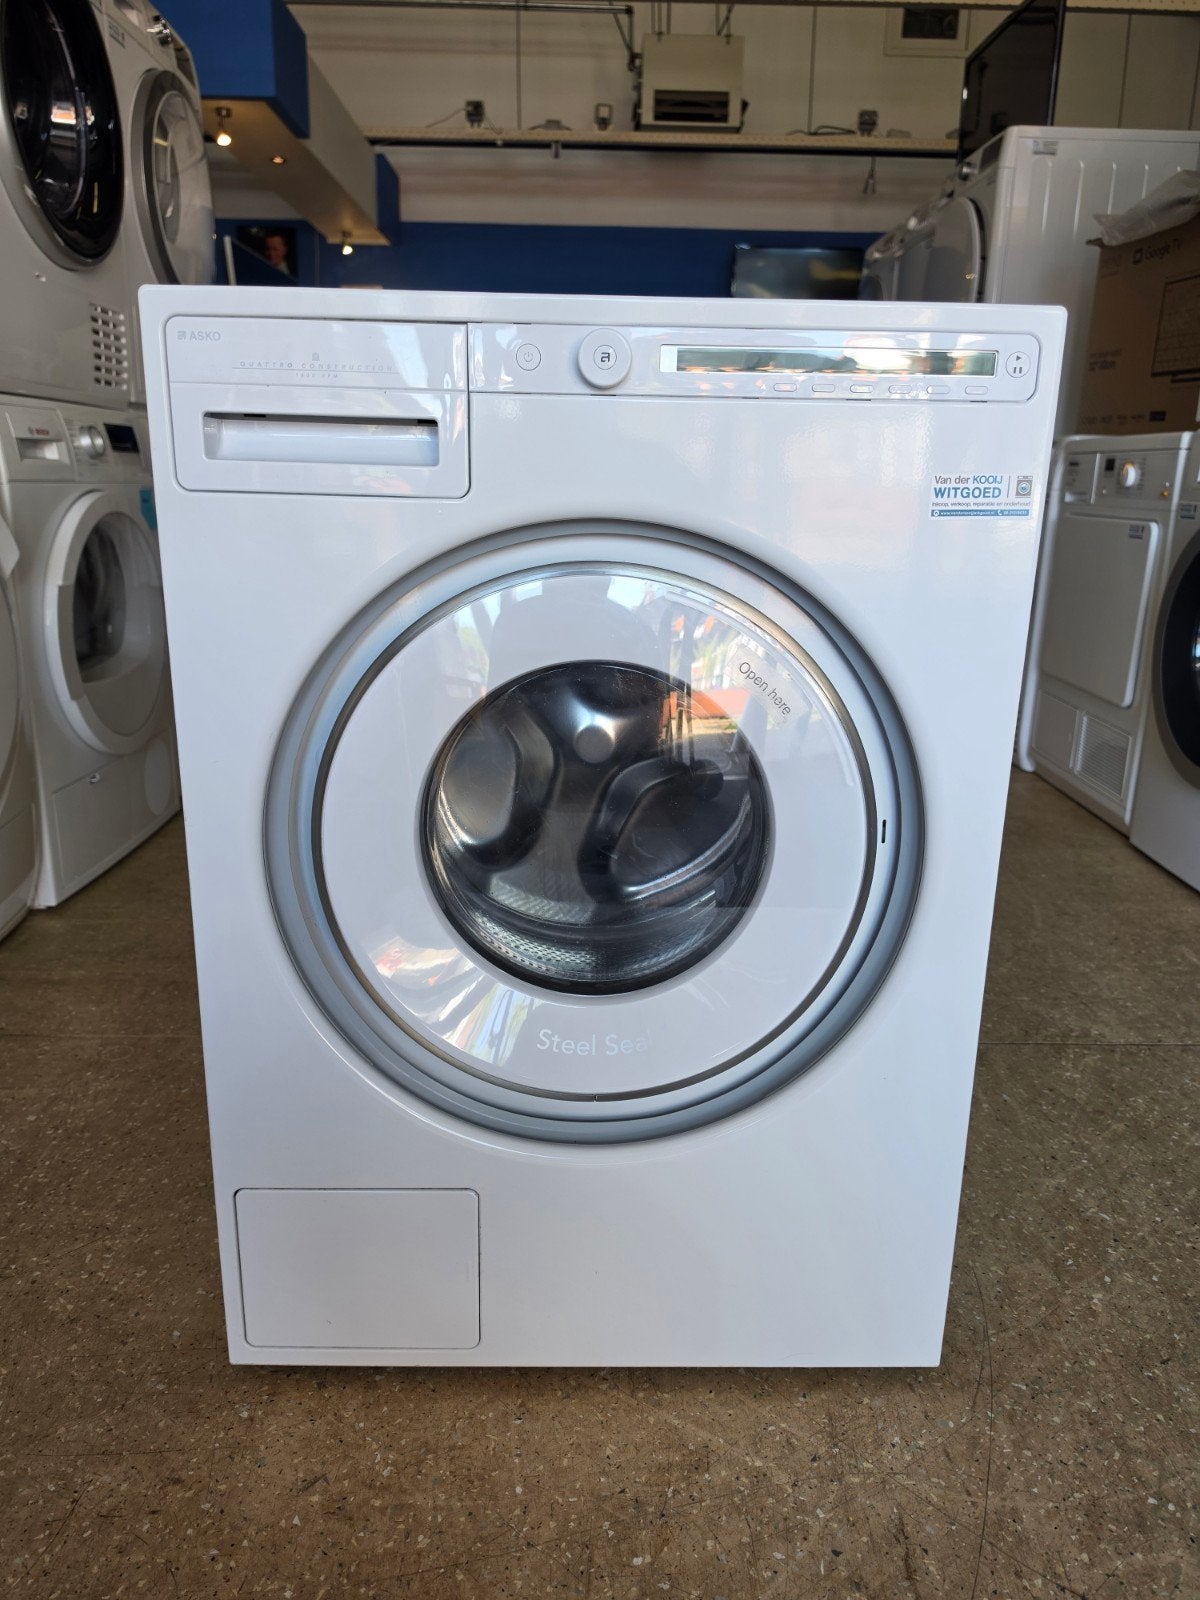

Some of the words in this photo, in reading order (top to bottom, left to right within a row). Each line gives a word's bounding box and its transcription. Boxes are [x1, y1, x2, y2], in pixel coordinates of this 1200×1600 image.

[189, 330, 221, 342] ASKO
[240, 361, 293, 369] QUATTRO
[302, 362, 393, 372] CONSTRUCTION
[935, 475, 951, 484] Van
[954, 475, 970, 484] der
[972, 475, 1002, 484] KOOIJ
[934, 487, 1002, 498] WITGOED
[739, 661, 769, 692] Open
[767, 687, 791, 715] here
[536, 1028, 596, 1056] Steel
